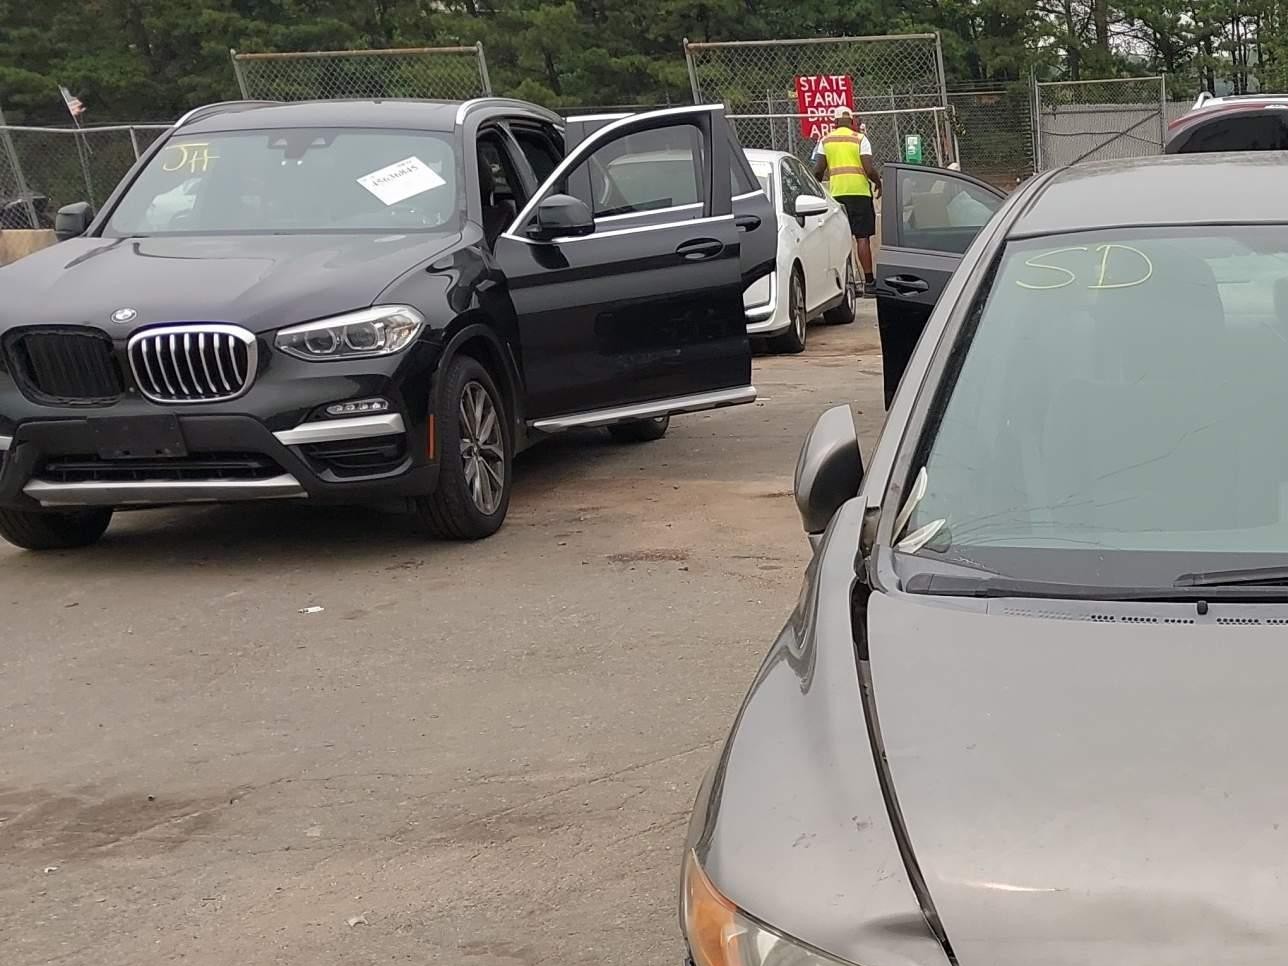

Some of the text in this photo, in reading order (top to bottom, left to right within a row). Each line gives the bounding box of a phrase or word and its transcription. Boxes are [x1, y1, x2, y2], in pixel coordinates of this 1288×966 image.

[800, 75, 847, 91] STATE
[804, 91, 847, 107] FARM
[807, 107, 837, 122] DRO
